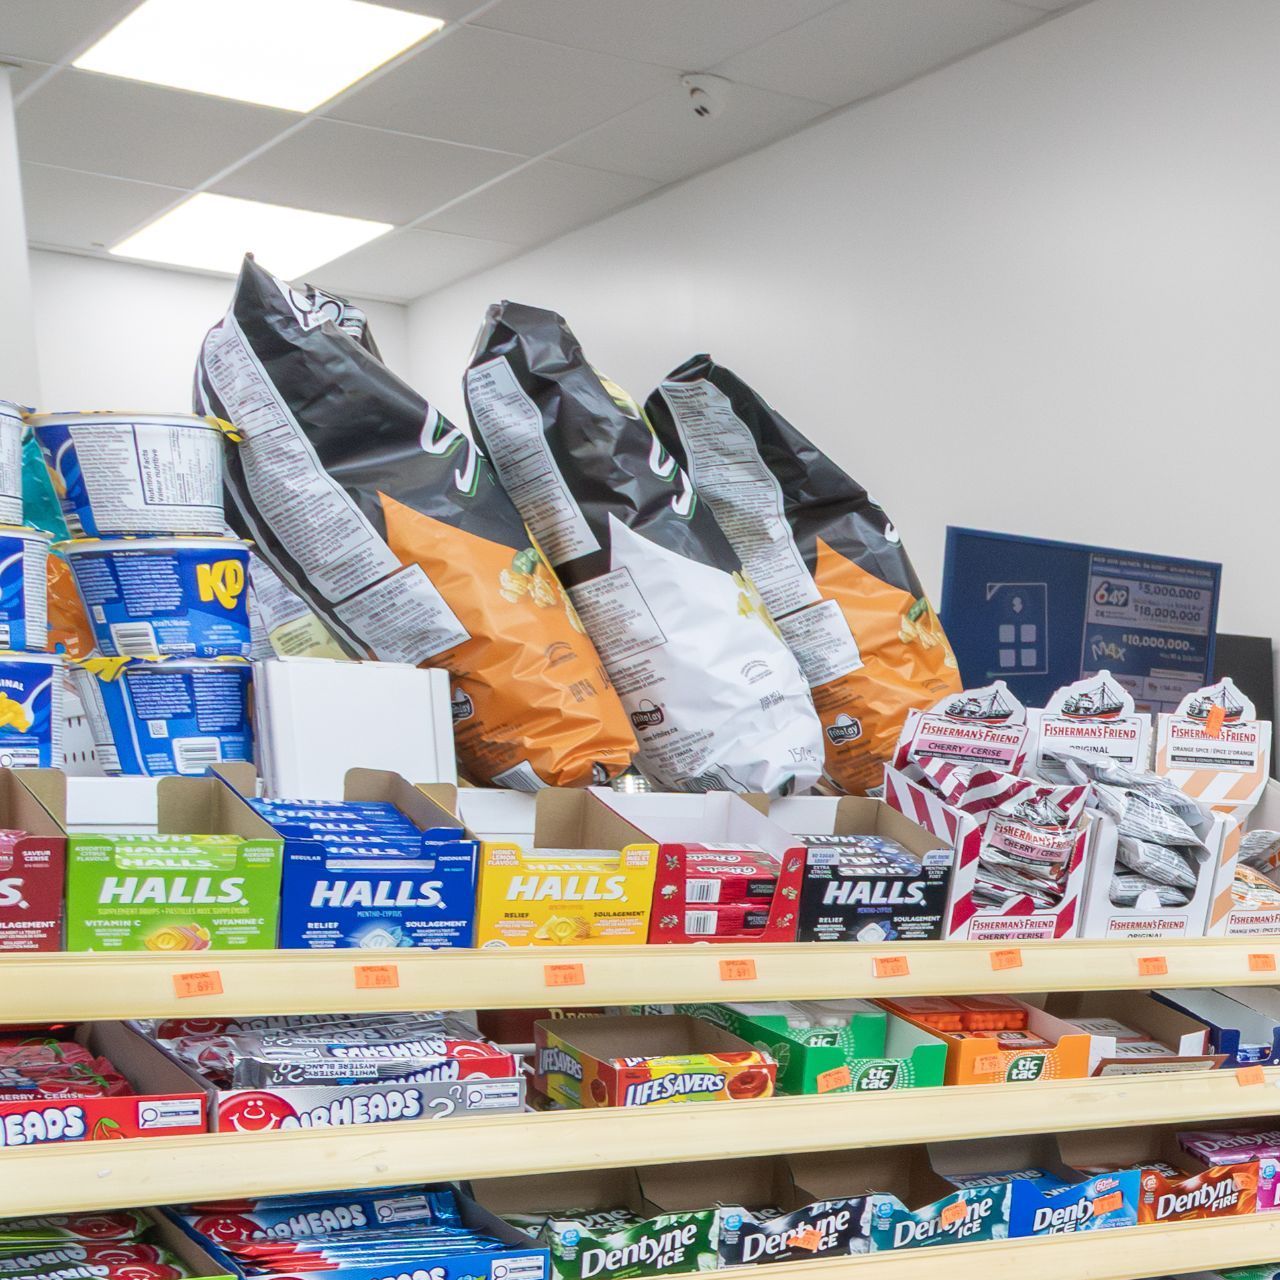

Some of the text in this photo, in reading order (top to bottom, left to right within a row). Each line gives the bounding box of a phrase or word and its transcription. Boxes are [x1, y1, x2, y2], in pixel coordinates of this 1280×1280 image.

[921, 724, 1019, 745] FISHERMAN'S FRIEND
[1044, 724, 1136, 739] FISHERMAN'S FRIEND
[1224, 730, 1256, 743] FRIEND
[100, 877, 243, 905] HALLS
[311, 880, 442, 908] HALLS
[506, 876, 624, 901] HALLS
[822, 880, 927, 905] HALLS
[973, 919, 1054, 930] FISHERMAN'S FRIEND
[1109, 919, 1184, 931] FISHERMAN'S FRIEND
[1230, 914, 1273, 924] FISHERMAN'S
[1017, 1056, 1040, 1070] tic
[867, 1067, 892, 1080] tic
[1011, 1067, 1038, 1080] tac
[626, 1072, 725, 1106] LIFESAVERS
[861, 1076, 890, 1090] tac
[1211, 1193, 1239, 1212] FIRE
[581, 1222, 697, 1279] Dentyne
[656, 1247, 684, 1269] ICE
